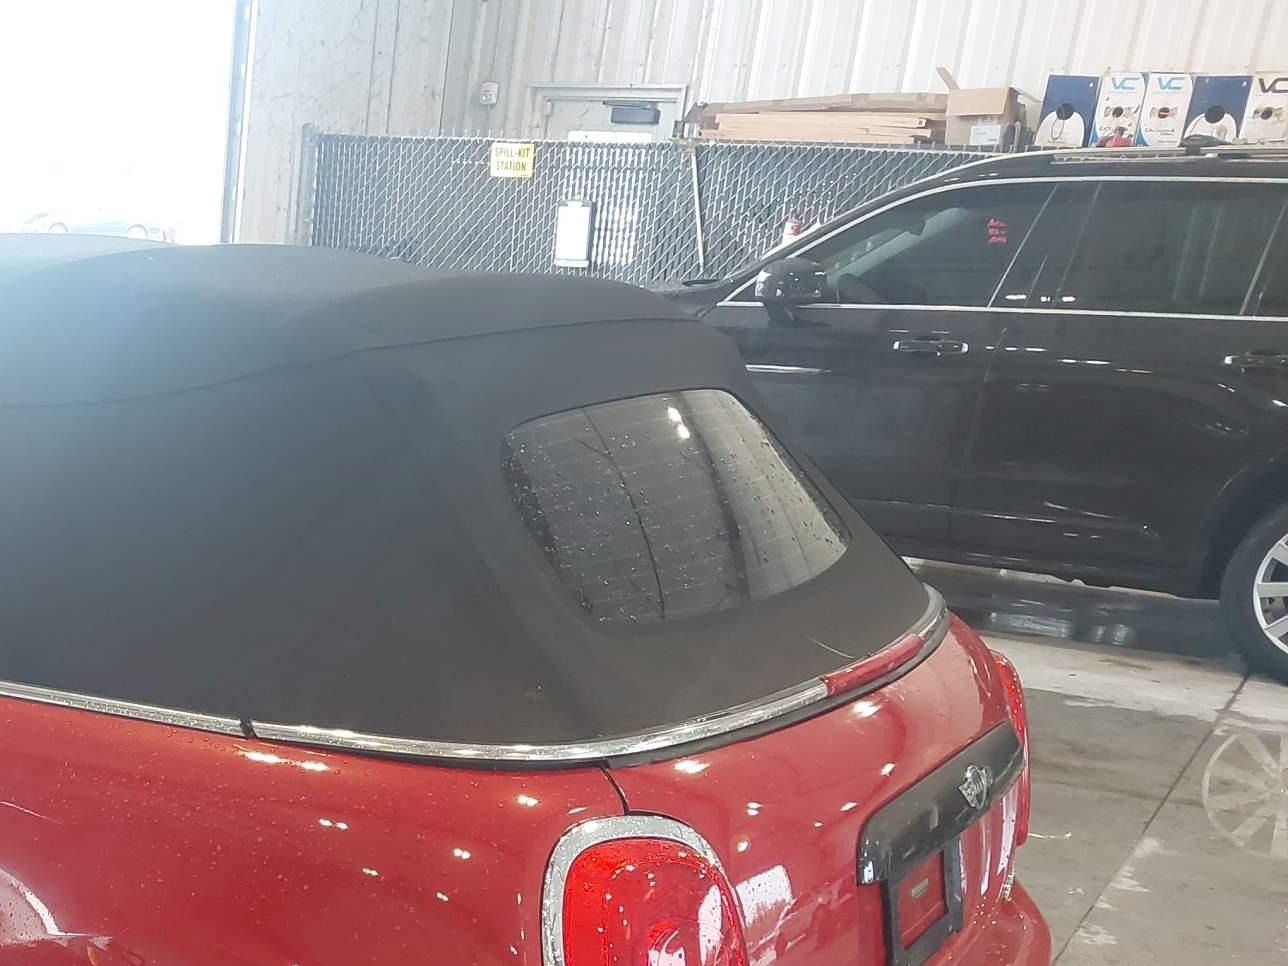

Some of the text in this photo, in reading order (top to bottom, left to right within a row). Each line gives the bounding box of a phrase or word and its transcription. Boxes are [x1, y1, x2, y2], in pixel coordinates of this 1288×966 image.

[1112, 76, 1140, 91] VC
[1157, 76, 1186, 91] VC
[495, 147, 530, 158] SPILL-KIT
[496, 161, 526, 172] STATION
